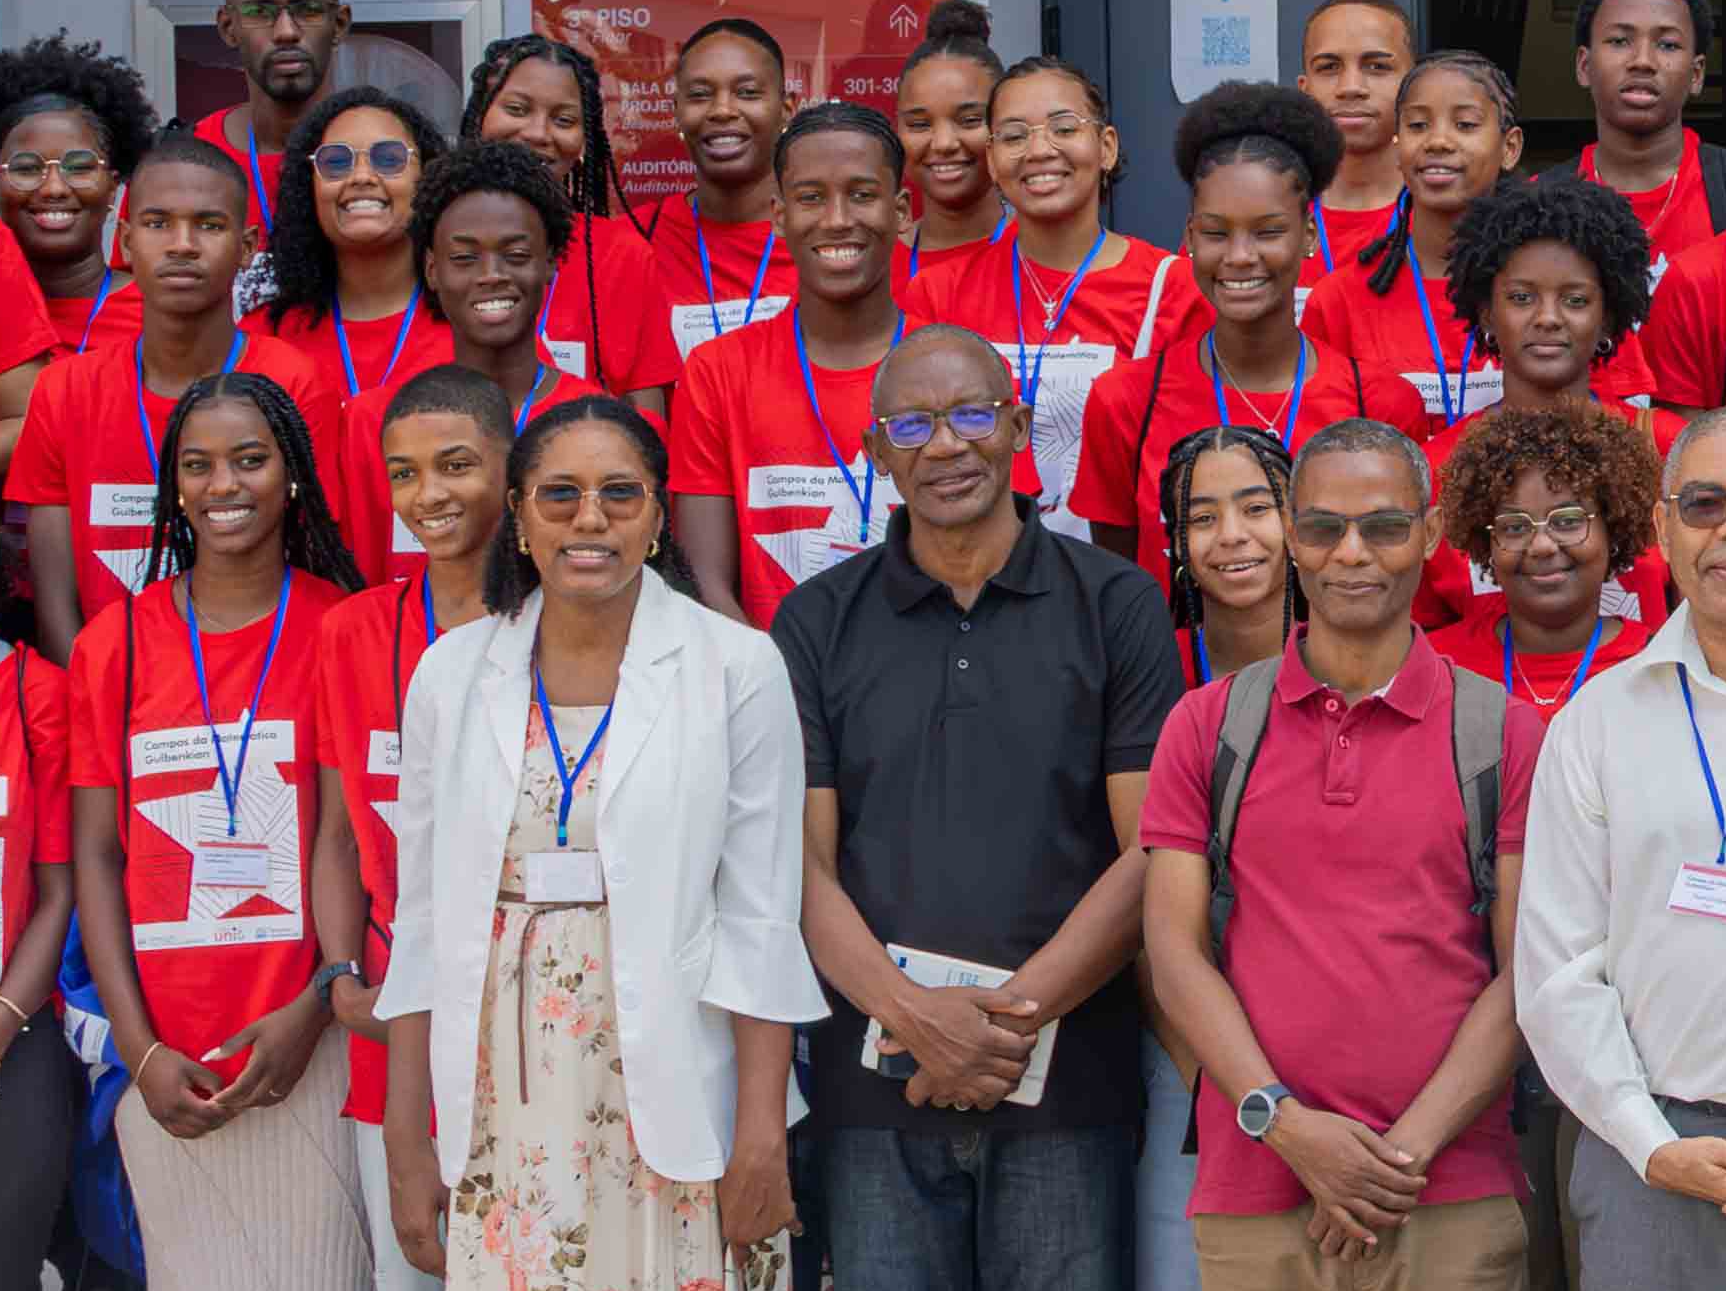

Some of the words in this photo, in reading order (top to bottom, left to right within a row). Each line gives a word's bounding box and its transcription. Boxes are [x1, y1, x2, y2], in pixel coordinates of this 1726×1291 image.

[594, 7, 651, 28] PISO
[143, 737, 191, 753] Campos
[144, 750, 212, 766] Gulbenkian
